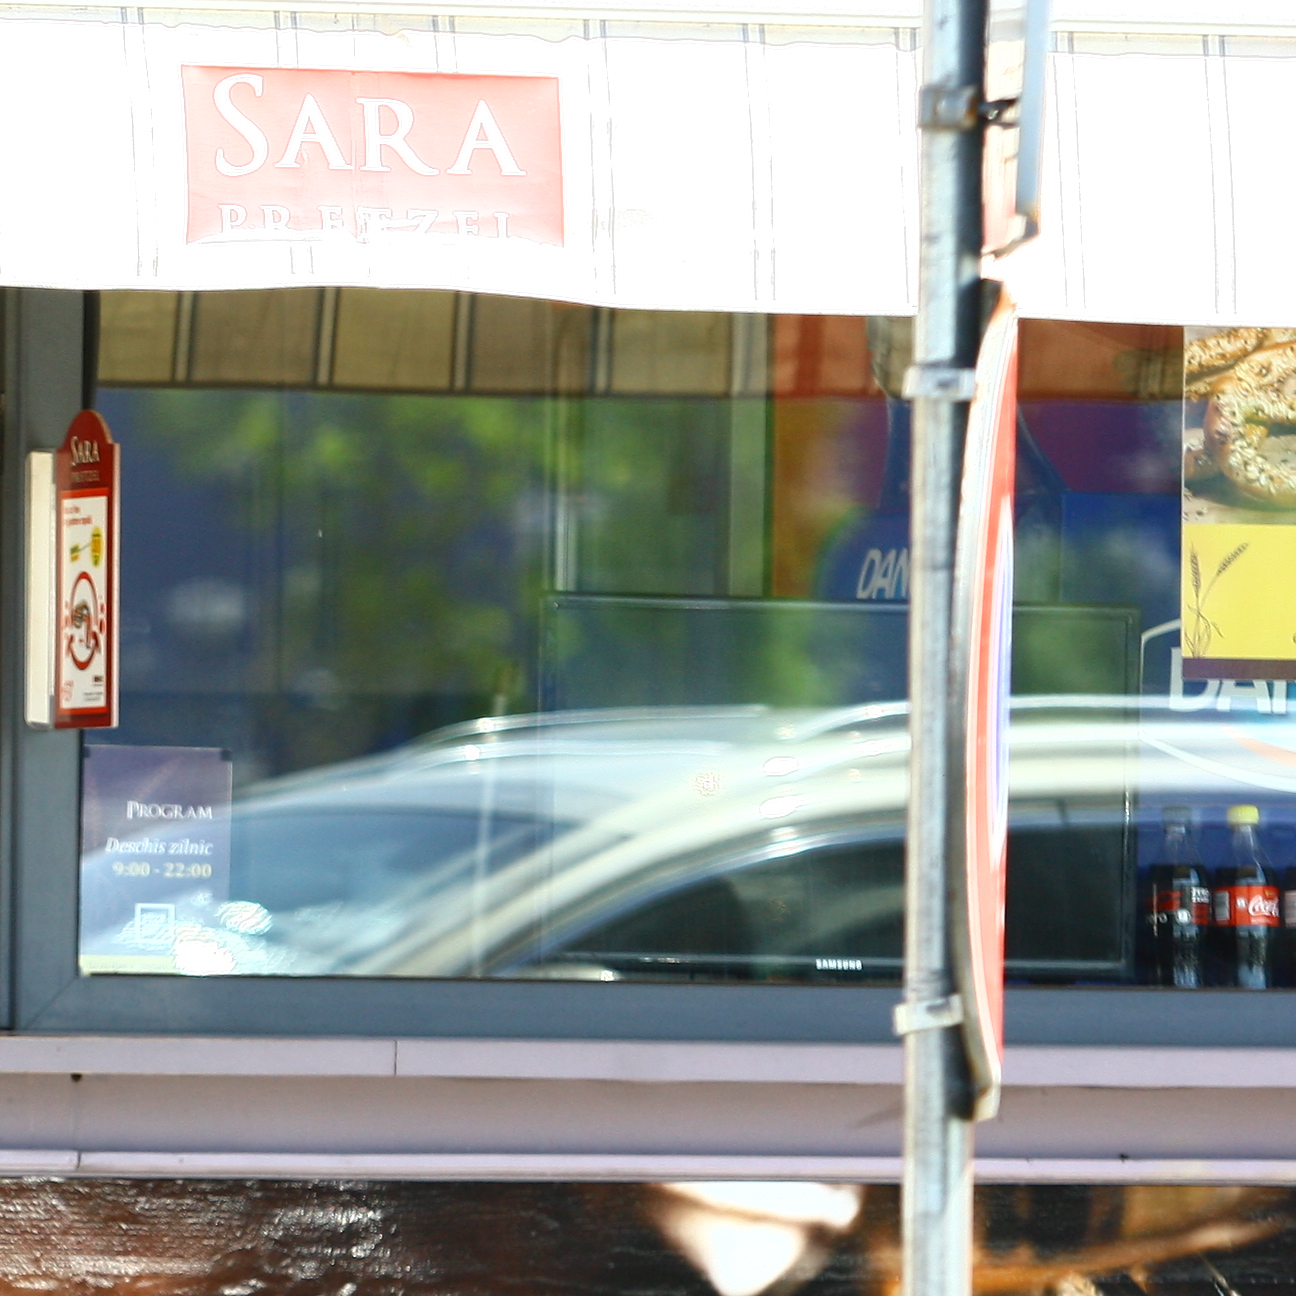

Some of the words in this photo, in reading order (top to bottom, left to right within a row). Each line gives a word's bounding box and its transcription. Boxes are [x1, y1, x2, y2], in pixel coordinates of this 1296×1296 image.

[212, 73, 527, 177] SARA
[70, 436, 100, 466] SARA
[126, 800, 213, 820] PROGRAM
[105, 837, 166, 855] Deschis
[168, 837, 214, 856] zilnic
[112, 861, 151, 877] 9:00
[163, 861, 213, 878] 22:00
[815, 958, 863, 971] SAMSUNG
